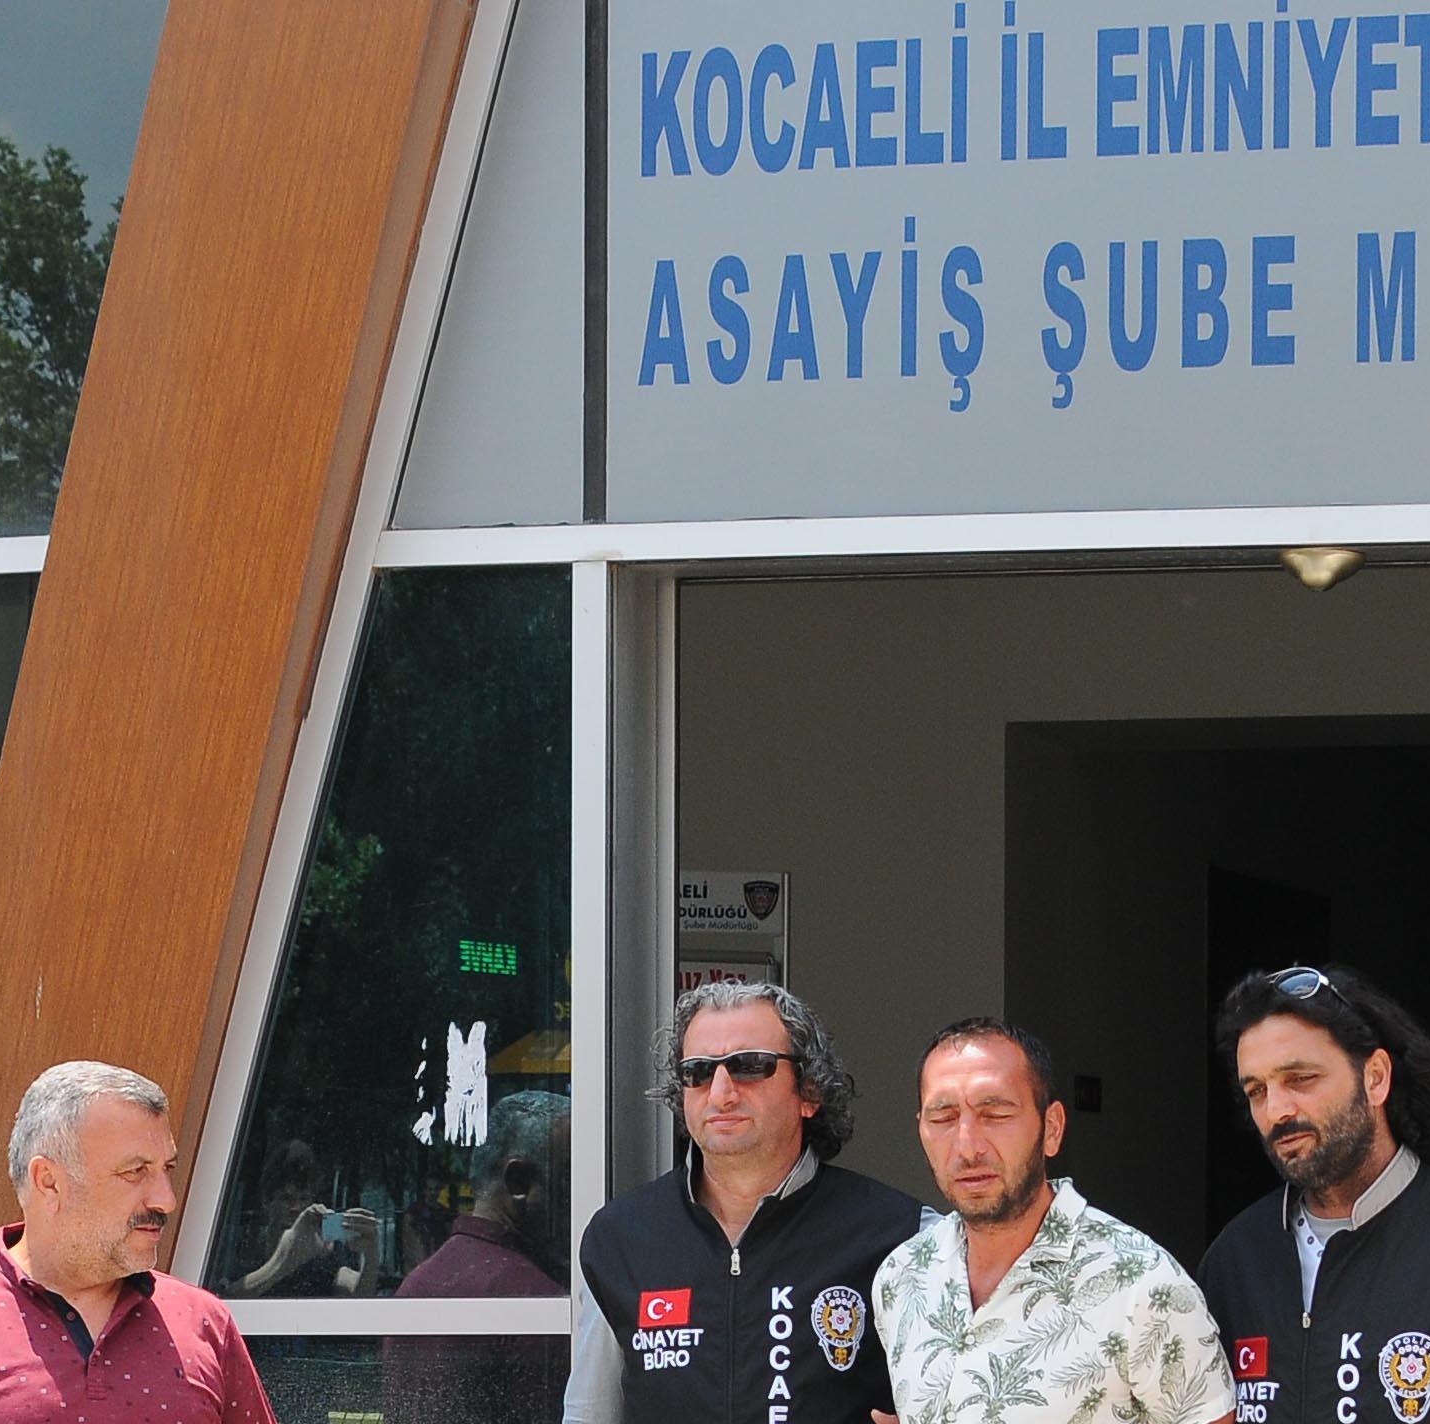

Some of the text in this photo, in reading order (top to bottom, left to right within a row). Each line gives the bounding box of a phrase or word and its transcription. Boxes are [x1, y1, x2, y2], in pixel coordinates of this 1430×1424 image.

[640, 1, 970, 176] KOCAELİ
[1000, 0, 1069, 161] İL
[638, 215, 985, 413] ASAYİŞ
[1040, 235, 1298, 409] ŞUBE
[679, 880, 708, 899] ELİ
[631, 1328, 705, 1351] CİNAYET
[643, 1348, 691, 1371] BÜRO
